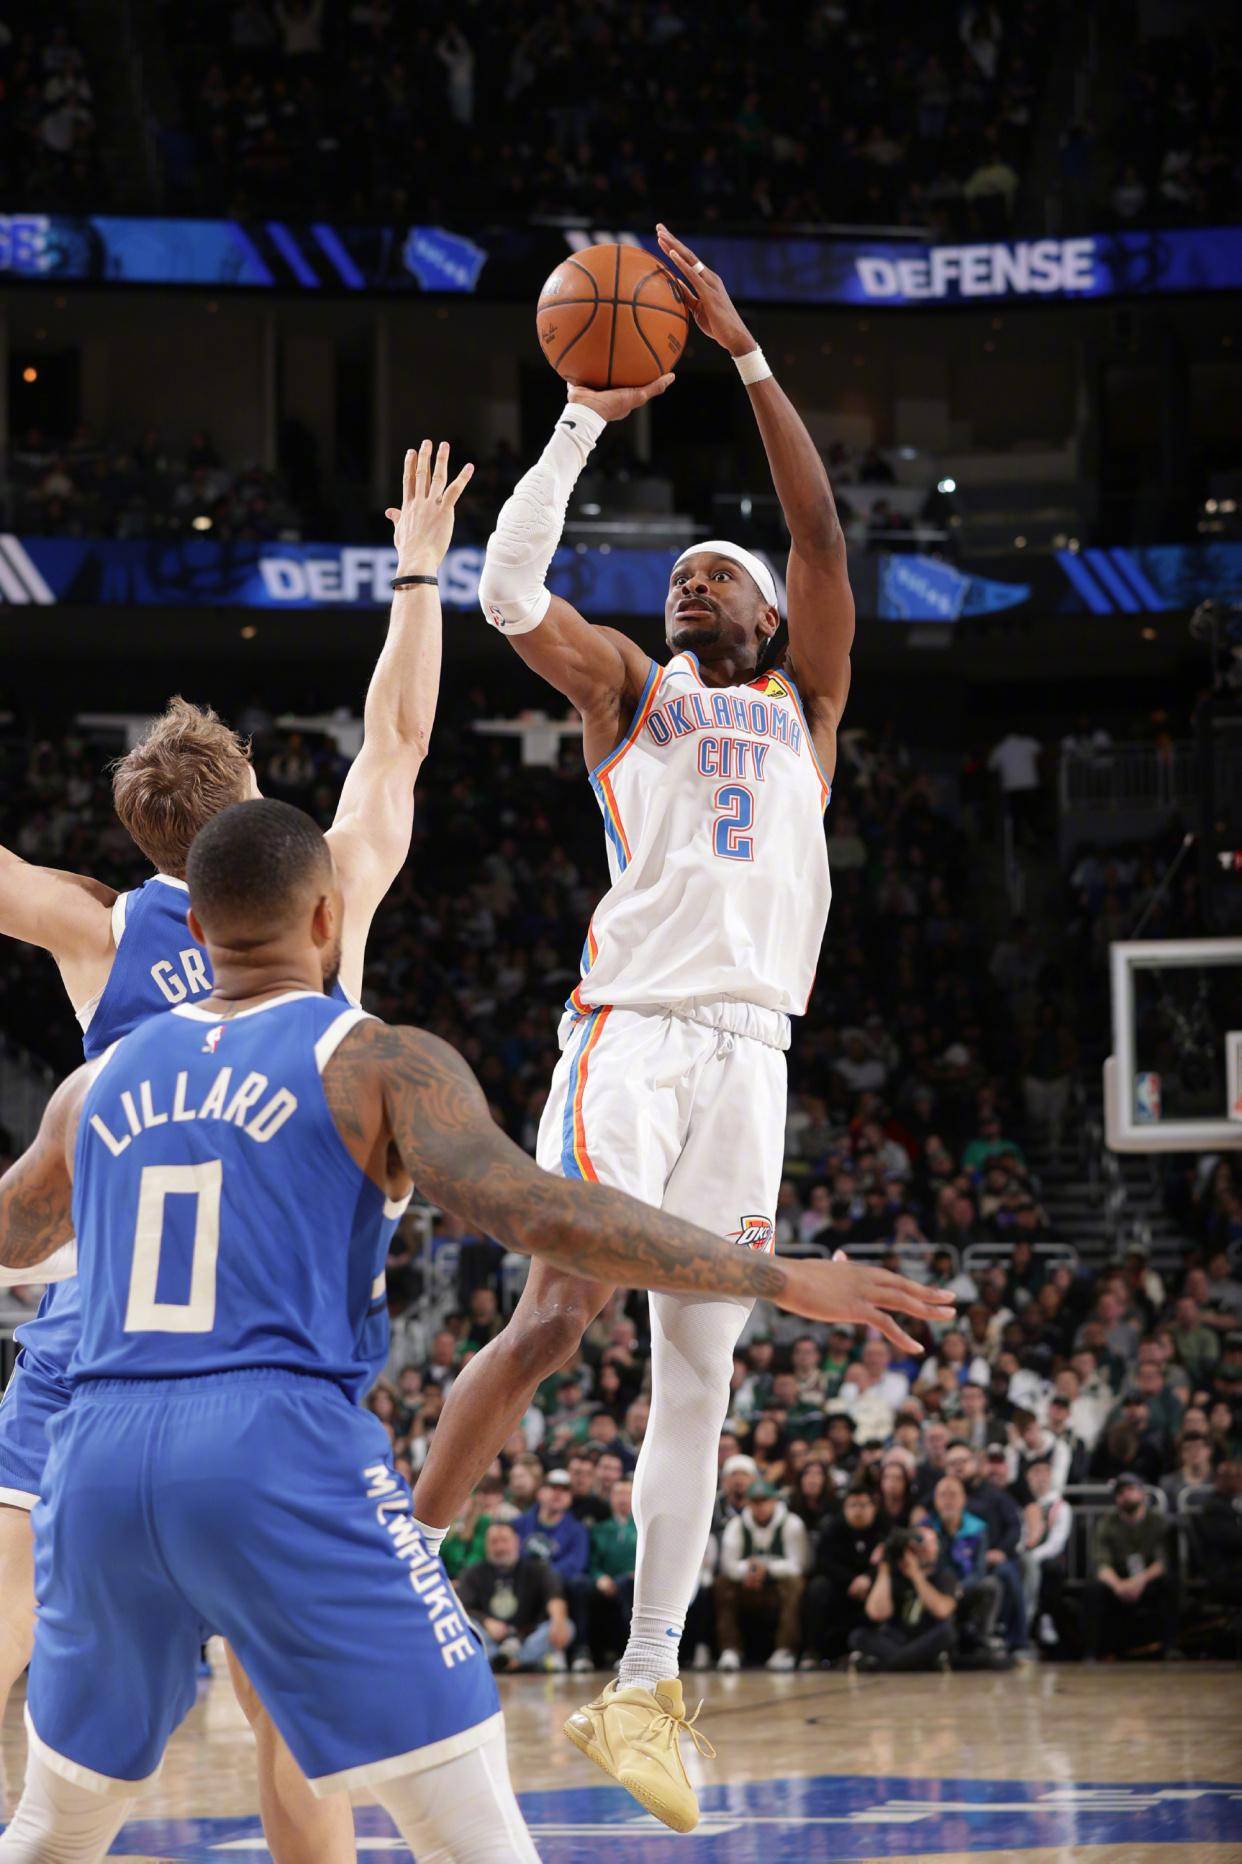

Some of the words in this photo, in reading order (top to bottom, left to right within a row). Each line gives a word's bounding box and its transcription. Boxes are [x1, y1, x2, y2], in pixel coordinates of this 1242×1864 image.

[855, 236, 1097, 299] DEFENSE
[257, 546, 486, 604] DEFES
[645, 692, 803, 757] OKLAHOMA
[697, 736, 770, 782] CITY
[712, 782, 755, 863] 2
[150, 948, 213, 1004] GR
[89, 1066, 299, 1158] LILLARD
[123, 1158, 223, 1334] 0
[362, 1463, 477, 1669] MILWAUKEE
